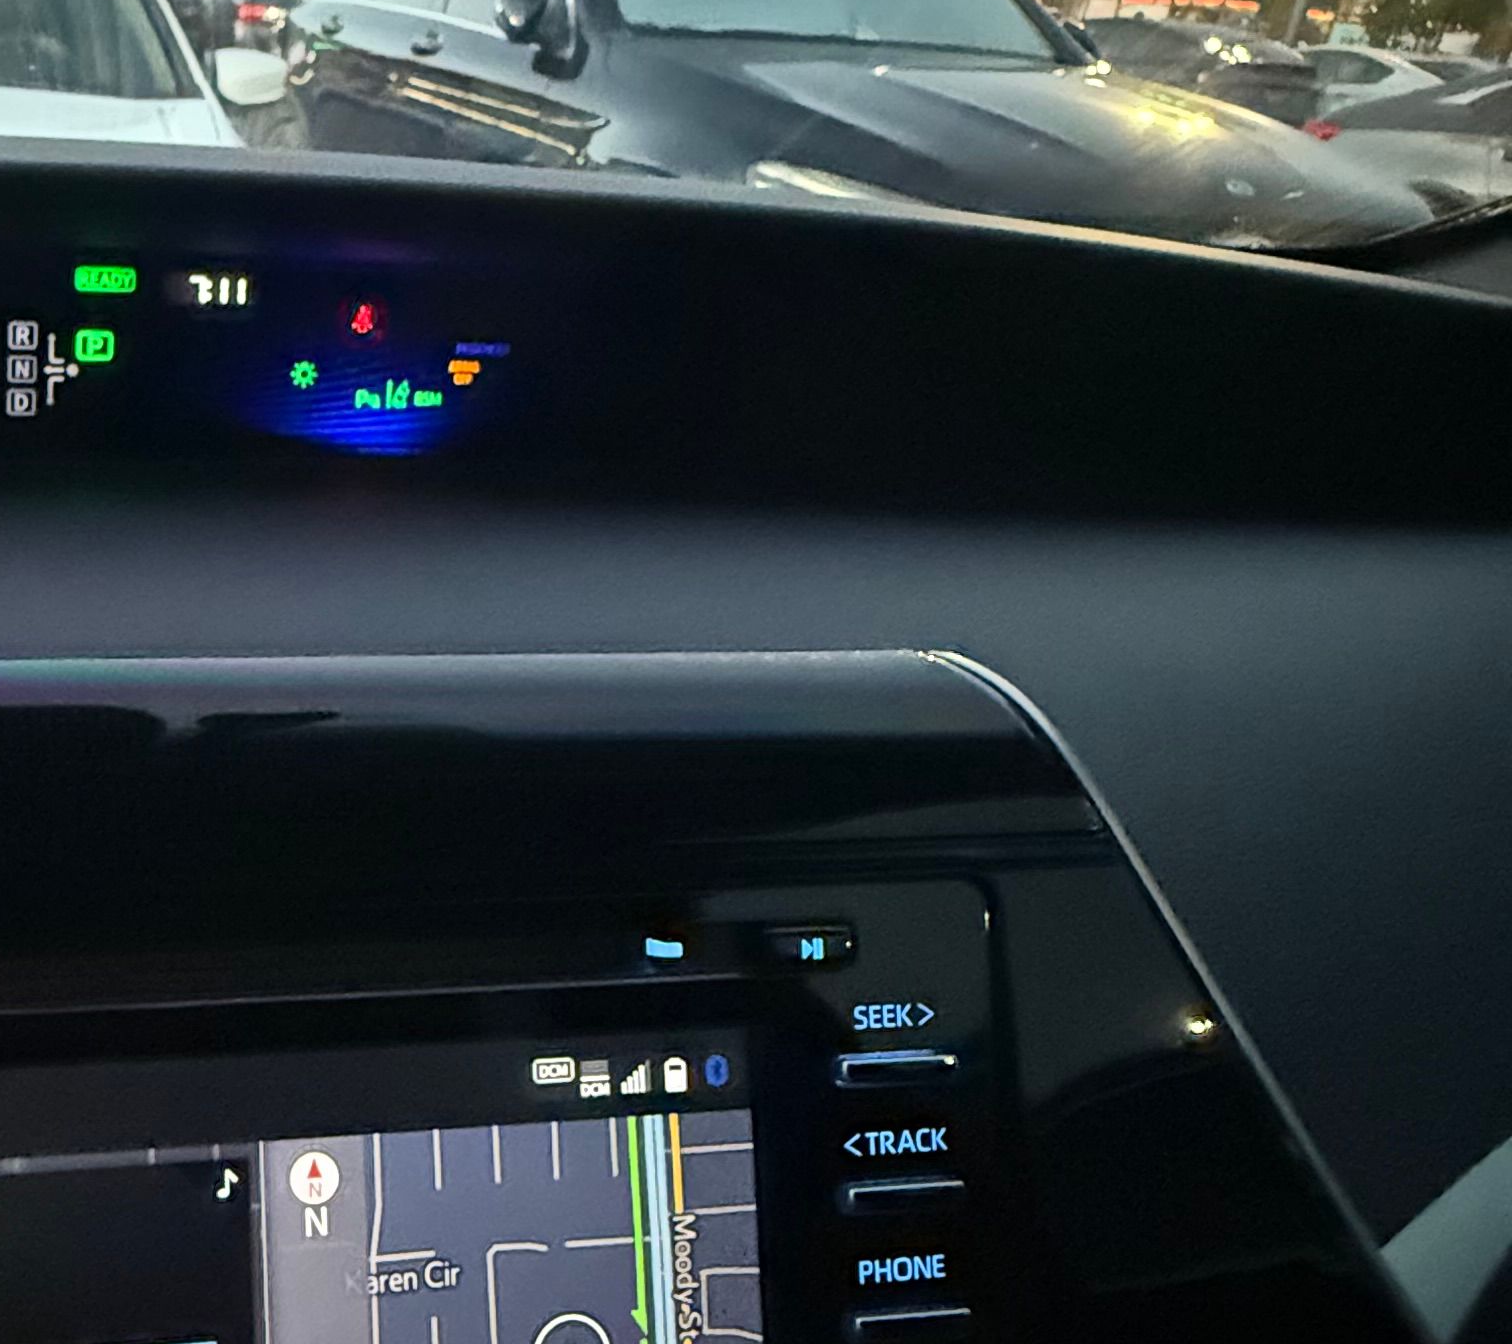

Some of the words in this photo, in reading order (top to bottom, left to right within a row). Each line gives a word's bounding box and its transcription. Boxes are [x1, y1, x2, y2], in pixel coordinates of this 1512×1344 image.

[79, 270, 135, 290] READY
[15, 327, 30, 345] R
[14, 360, 30, 378] N
[13, 393, 30, 412] D
[538, 1063, 569, 1078] DCM
[865, 1128, 948, 1156] TRACK
[308, 1182, 323, 1199] N
[304, 1205, 329, 1237] N
[672, 1214, 700, 1304] Moody
[858, 1254, 946, 1285] PHONE
[423, 1260, 461, 1288] Cir
[679, 1311, 703, 1341] St
